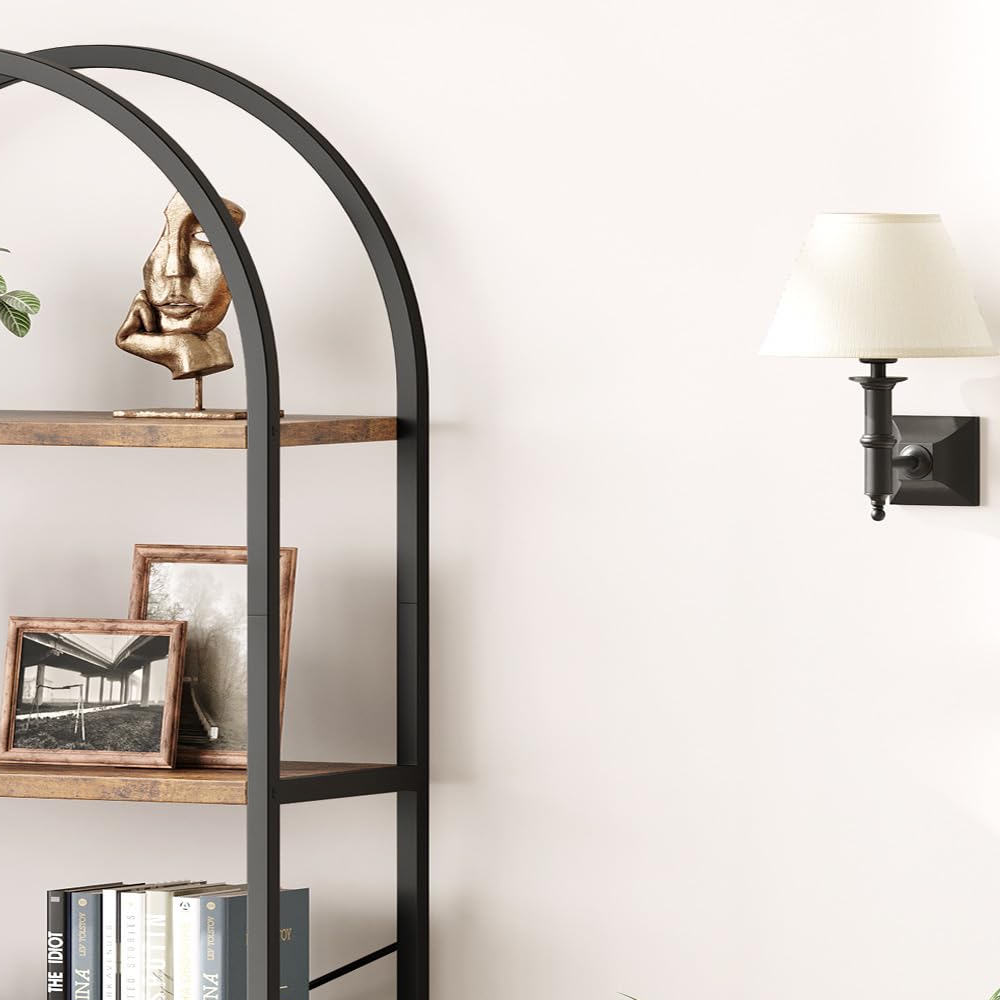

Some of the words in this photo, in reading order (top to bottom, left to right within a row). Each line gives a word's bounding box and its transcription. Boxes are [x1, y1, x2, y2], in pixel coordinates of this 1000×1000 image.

[48, 931, 63, 964] IDIOT
[126, 913, 136, 968] STORIES
[48, 971, 64, 993] THE
